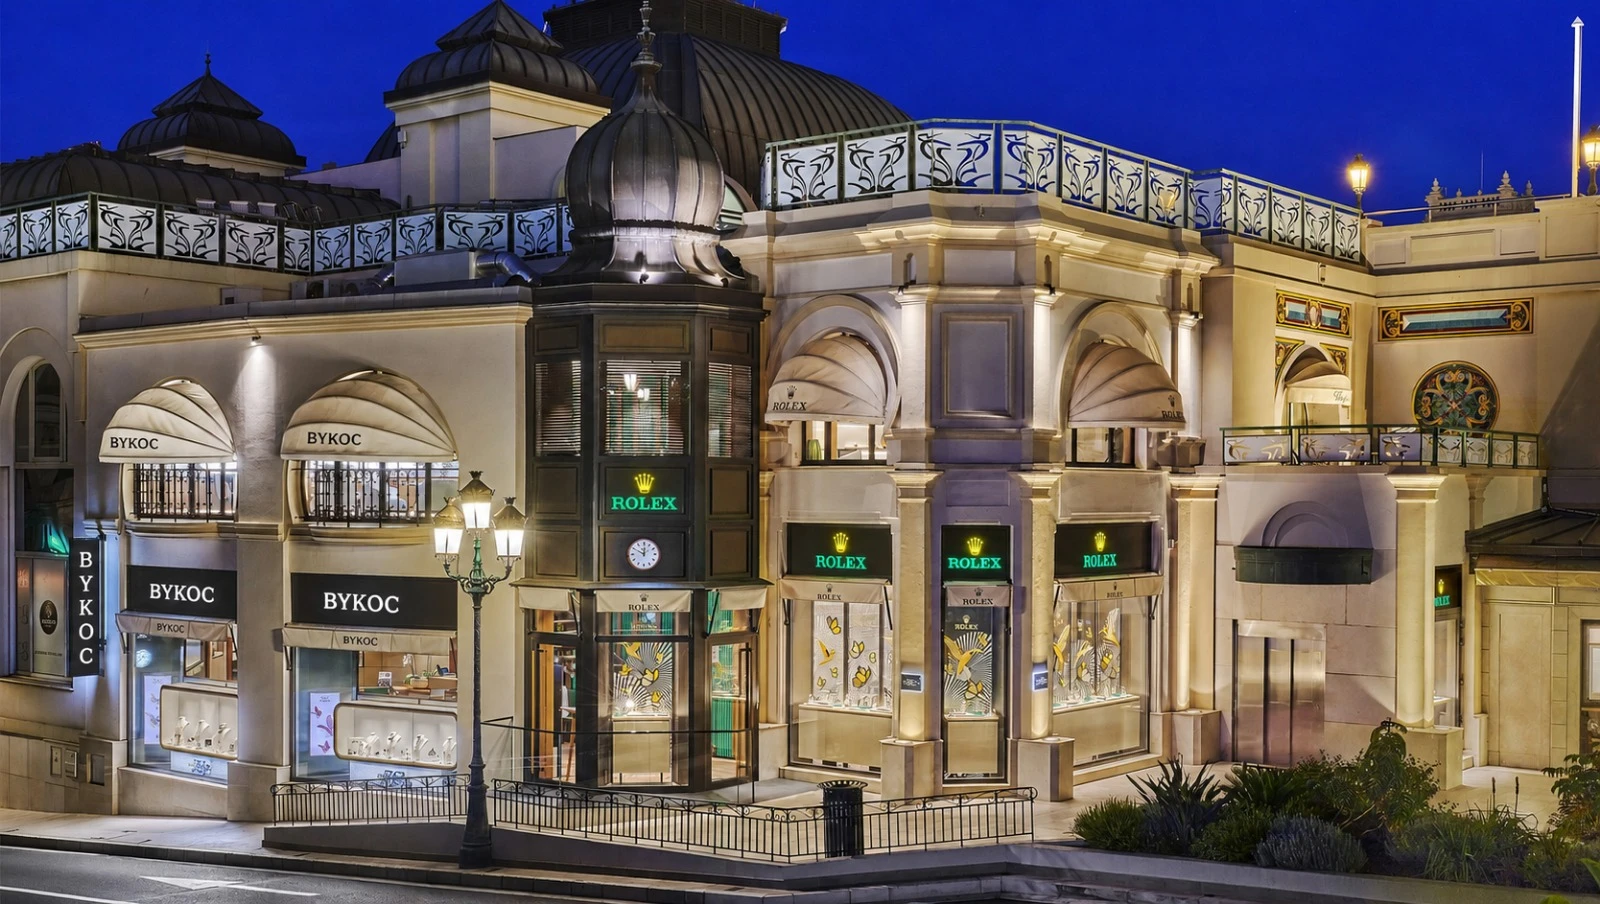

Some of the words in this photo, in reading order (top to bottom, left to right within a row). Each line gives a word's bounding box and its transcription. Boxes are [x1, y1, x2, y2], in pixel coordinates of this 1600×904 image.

[773, 402, 807, 411] ROLEX
[110, 437, 159, 449] BYKOC
[307, 432, 362, 446] BYKOC
[611, 496, 678, 510] ROLEX
[815, 554, 867, 570] ROLEX
[948, 558, 1002, 569] ROLEX
[1083, 554, 1118, 568] ROLEX
[149, 583, 215, 603] BYKOC
[79, 551, 94, 665] BYKOC
[323, 592, 400, 614] BYKOC
[156, 623, 185, 634] BYKOC
[343, 636, 378, 647] BYKOC
